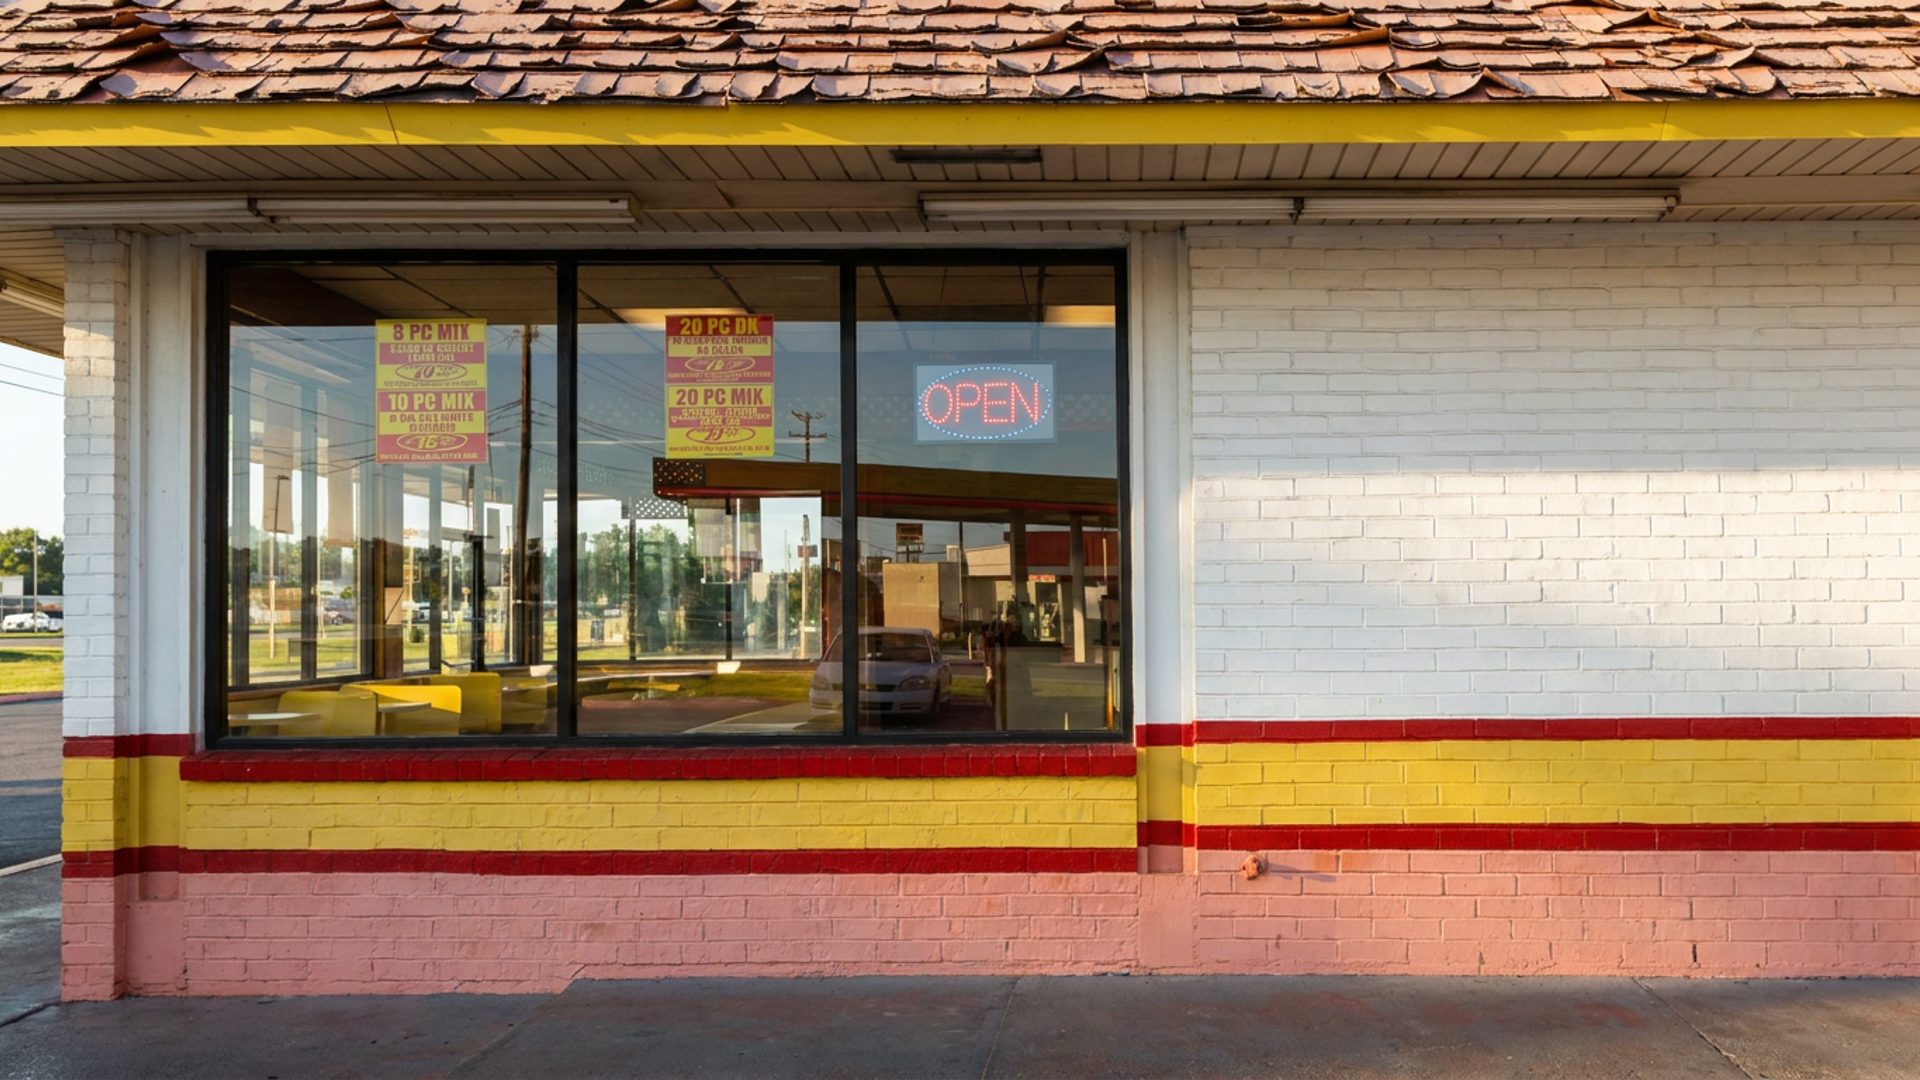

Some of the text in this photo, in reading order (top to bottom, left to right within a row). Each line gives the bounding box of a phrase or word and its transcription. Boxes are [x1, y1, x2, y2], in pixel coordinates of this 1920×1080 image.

[409, 323, 433, 341] PC
[680, 317, 702, 335] 20
[708, 317, 730, 335] PC
[388, 392, 474, 411] 10 PC MIX
[676, 388, 699, 405] 20
[704, 388, 726, 405] PC
[923, 381, 1040, 424] OPEN
